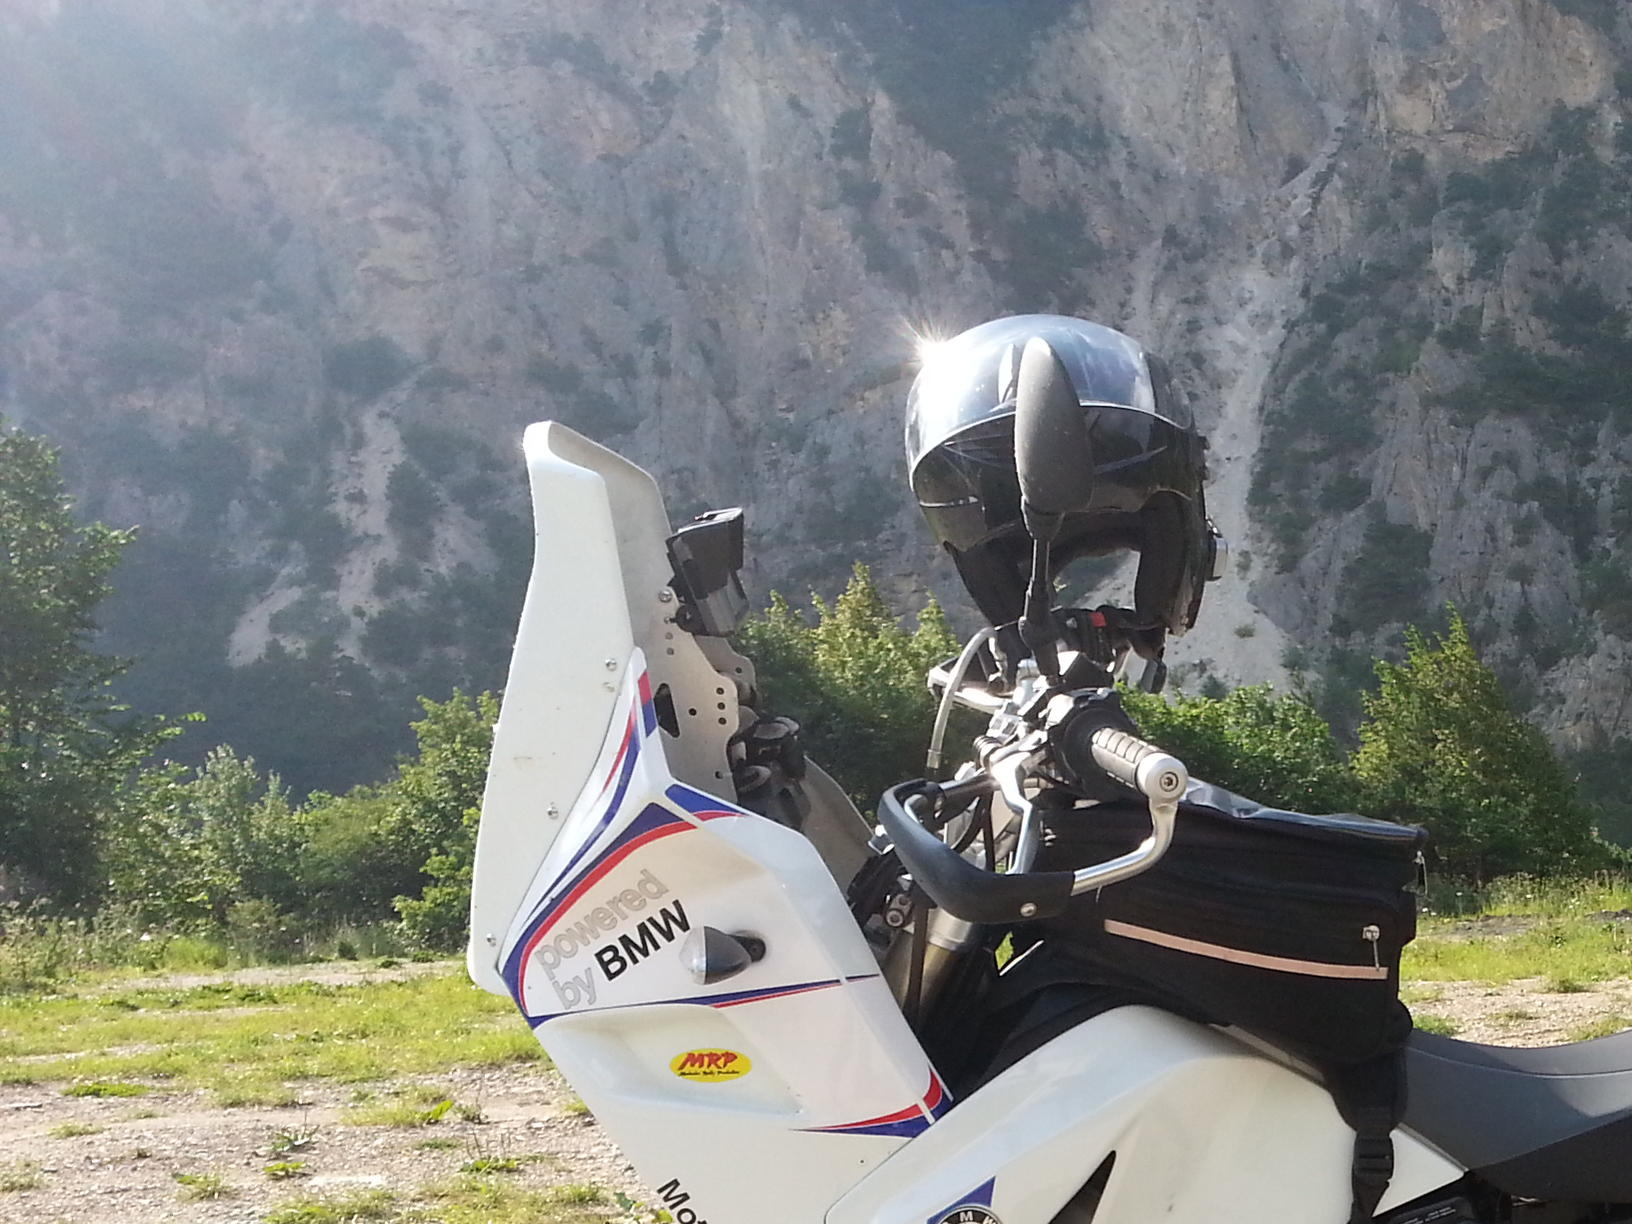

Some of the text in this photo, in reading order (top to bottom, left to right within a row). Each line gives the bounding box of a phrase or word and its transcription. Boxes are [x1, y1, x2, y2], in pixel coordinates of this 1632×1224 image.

[534, 869, 669, 982] powered
[554, 898, 692, 1011] by BMW
[677, 1050, 737, 1071] MRP
